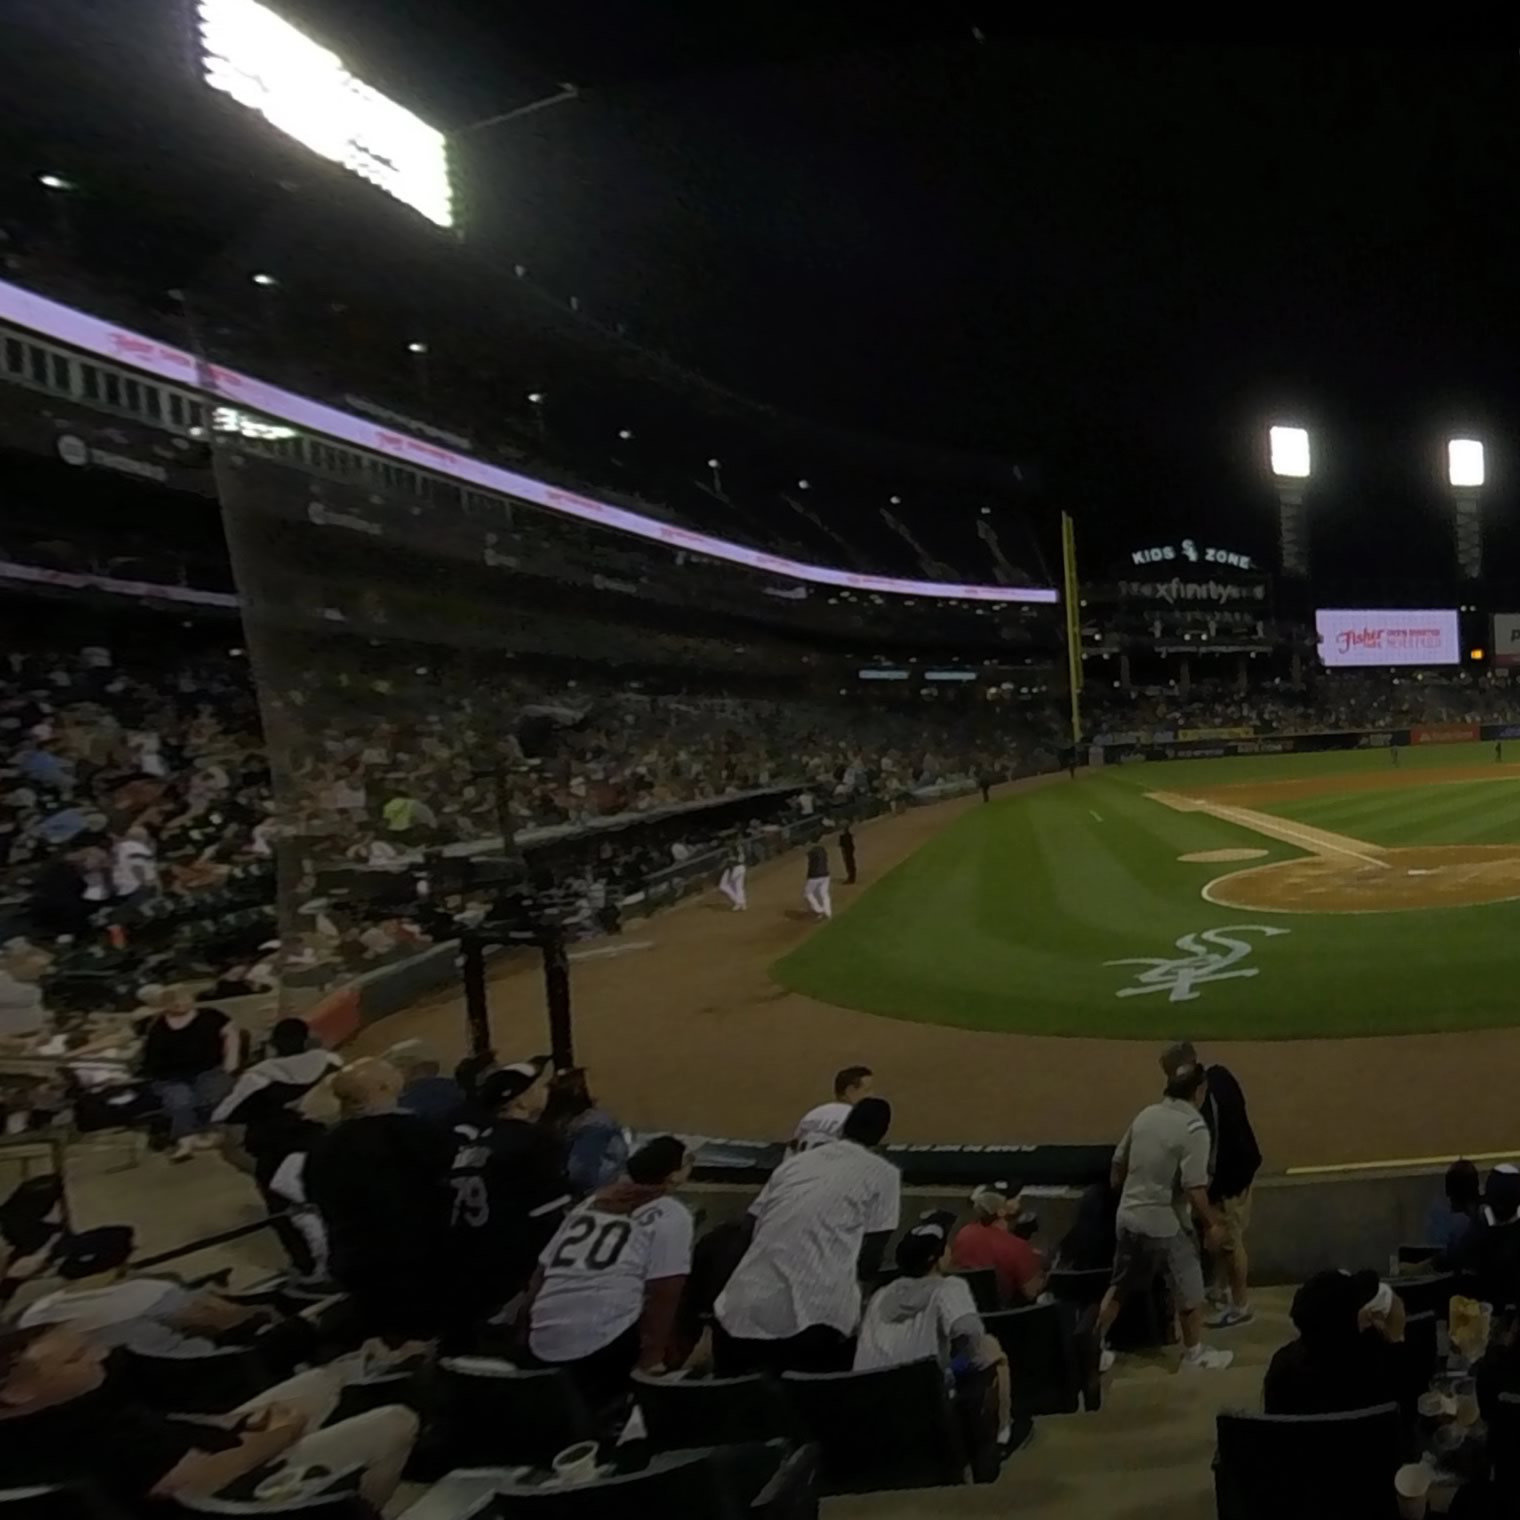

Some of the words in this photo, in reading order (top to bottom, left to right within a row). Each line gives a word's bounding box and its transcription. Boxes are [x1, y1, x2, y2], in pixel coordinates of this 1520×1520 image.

[1131, 546, 1176, 565] KIDS
[1204, 548, 1251, 569] ZONE
[1155, 577, 1232, 604] xfinity
[449, 1175, 490, 1229] 79
[550, 1215, 632, 1270] 20
